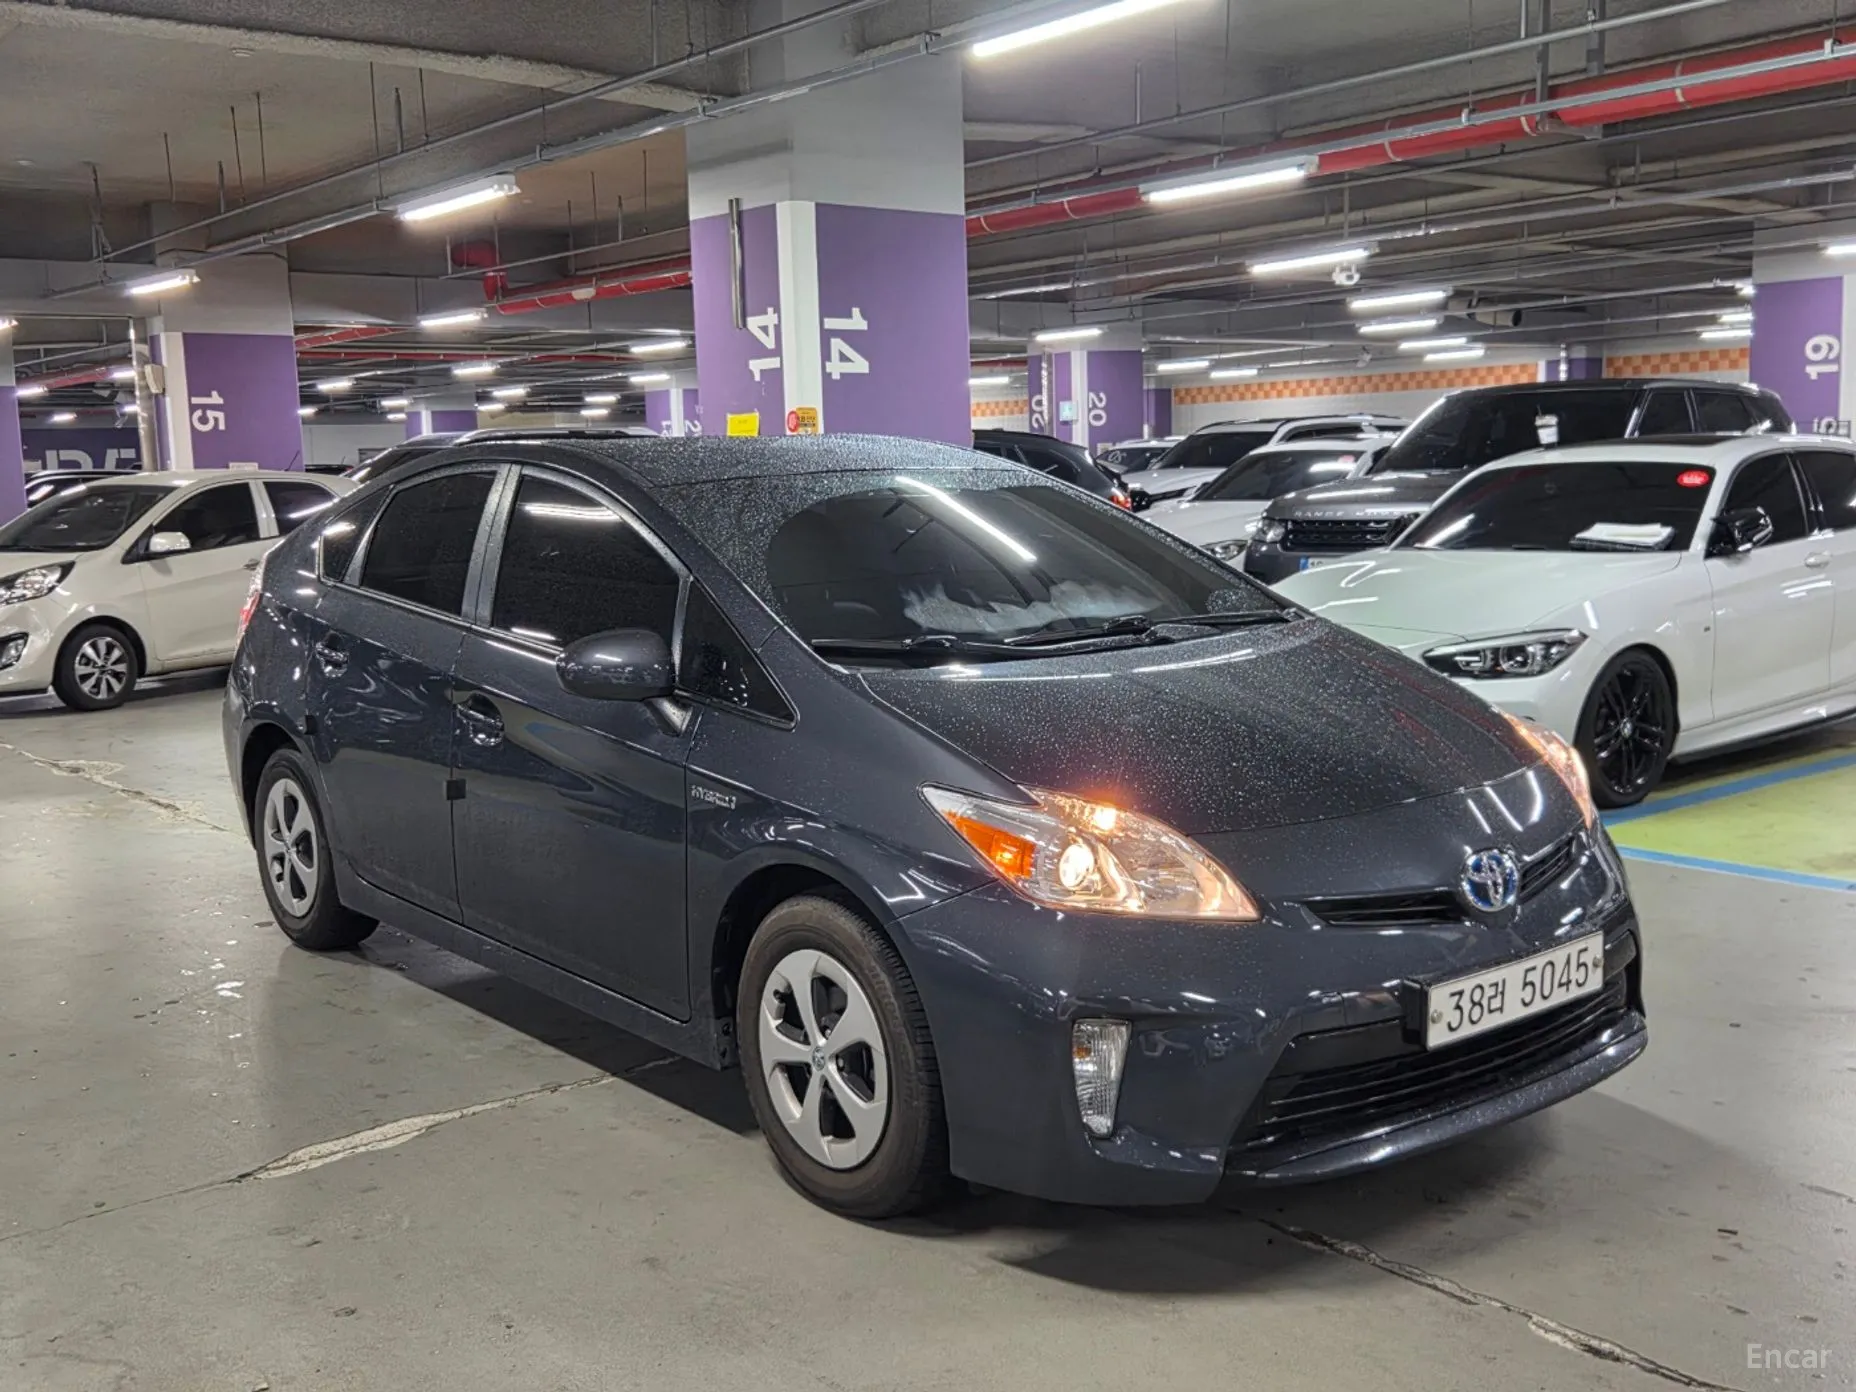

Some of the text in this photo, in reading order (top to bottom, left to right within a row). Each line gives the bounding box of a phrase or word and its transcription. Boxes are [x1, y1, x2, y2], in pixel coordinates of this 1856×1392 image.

[746, 307, 781, 382] 14
[823, 307, 870, 380] 14
[1804, 334, 1840, 380] 19
[191, 389, 226, 432] 15
[684, 419, 703, 437] 2
[1088, 391, 1107, 427] 20
[1446, 946, 1589, 1033] 38러 5045
